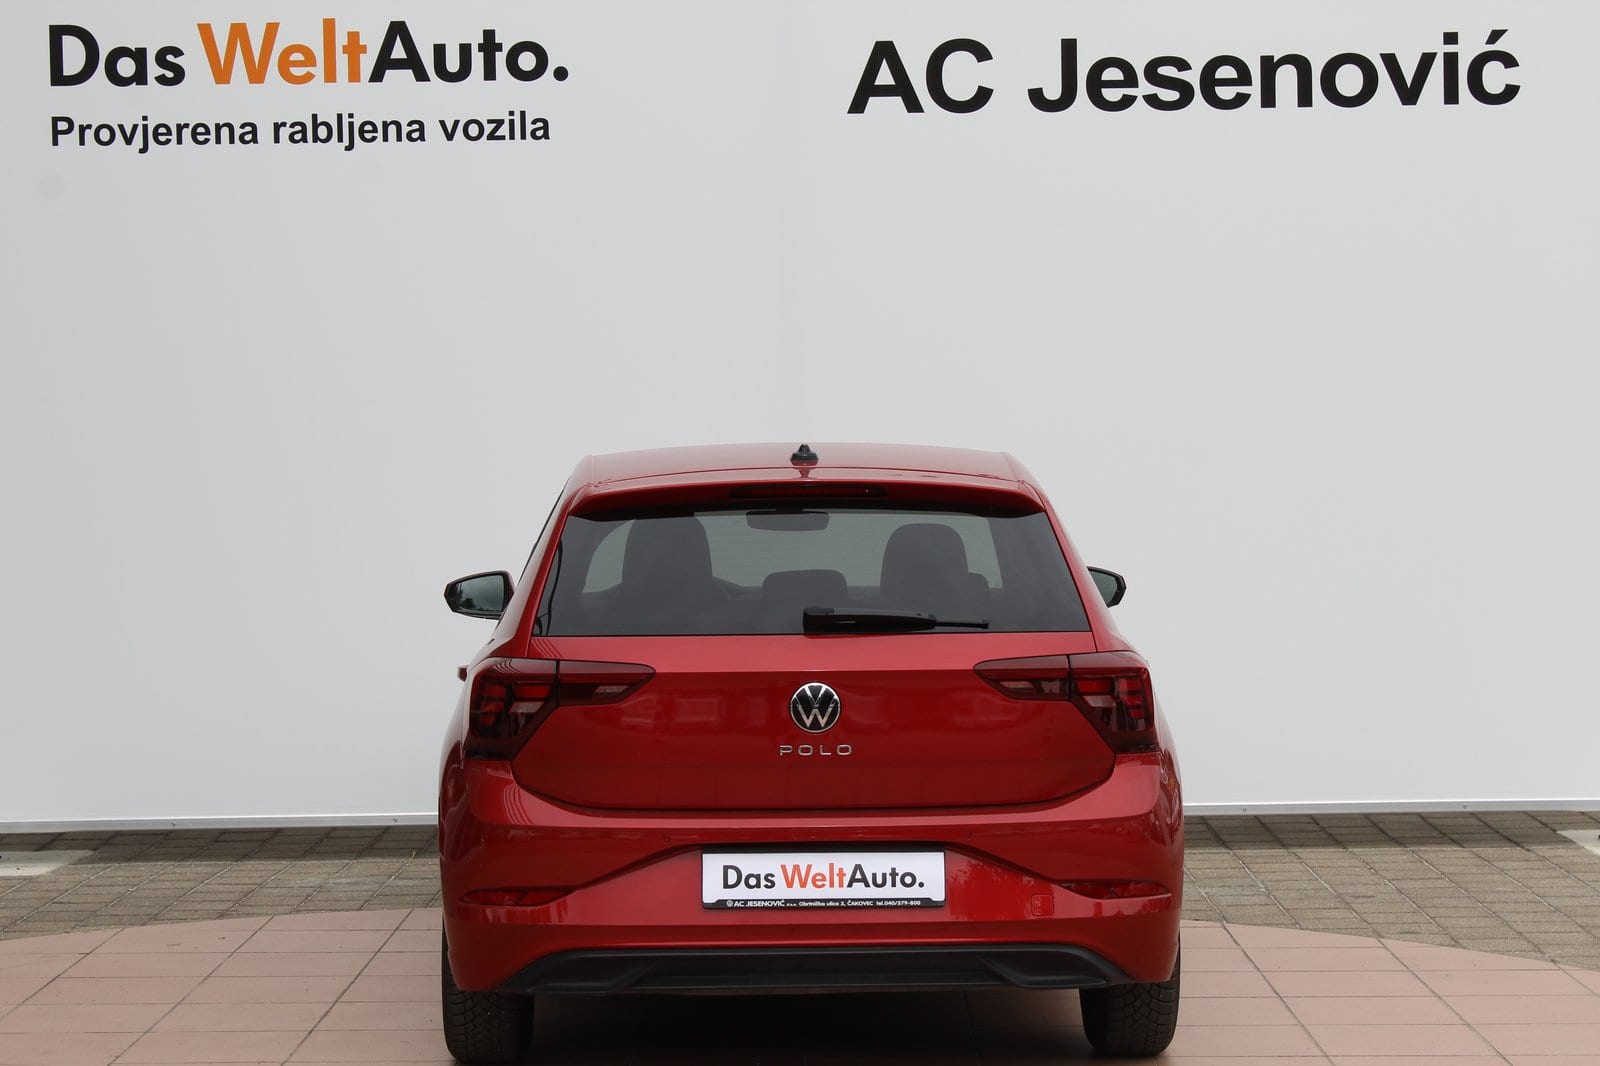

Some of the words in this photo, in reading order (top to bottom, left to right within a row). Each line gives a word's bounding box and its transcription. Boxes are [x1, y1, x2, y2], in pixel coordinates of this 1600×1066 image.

[49, 25, 185, 87] Das
[197, 18, 568, 84] WeltAuto.
[847, 39, 993, 114] AC
[1028, 29, 1521, 112] Jesenović
[51, 115, 259, 154] Provjerena
[273, 112, 426, 151] rabljena
[438, 110, 551, 141] vozila
[779, 744, 852, 756] POLO
[722, 864, 776, 889] Das
[780, 862, 925, 888] WeltAuto.
[746, 899, 785, 907] JESENOVIĆ
